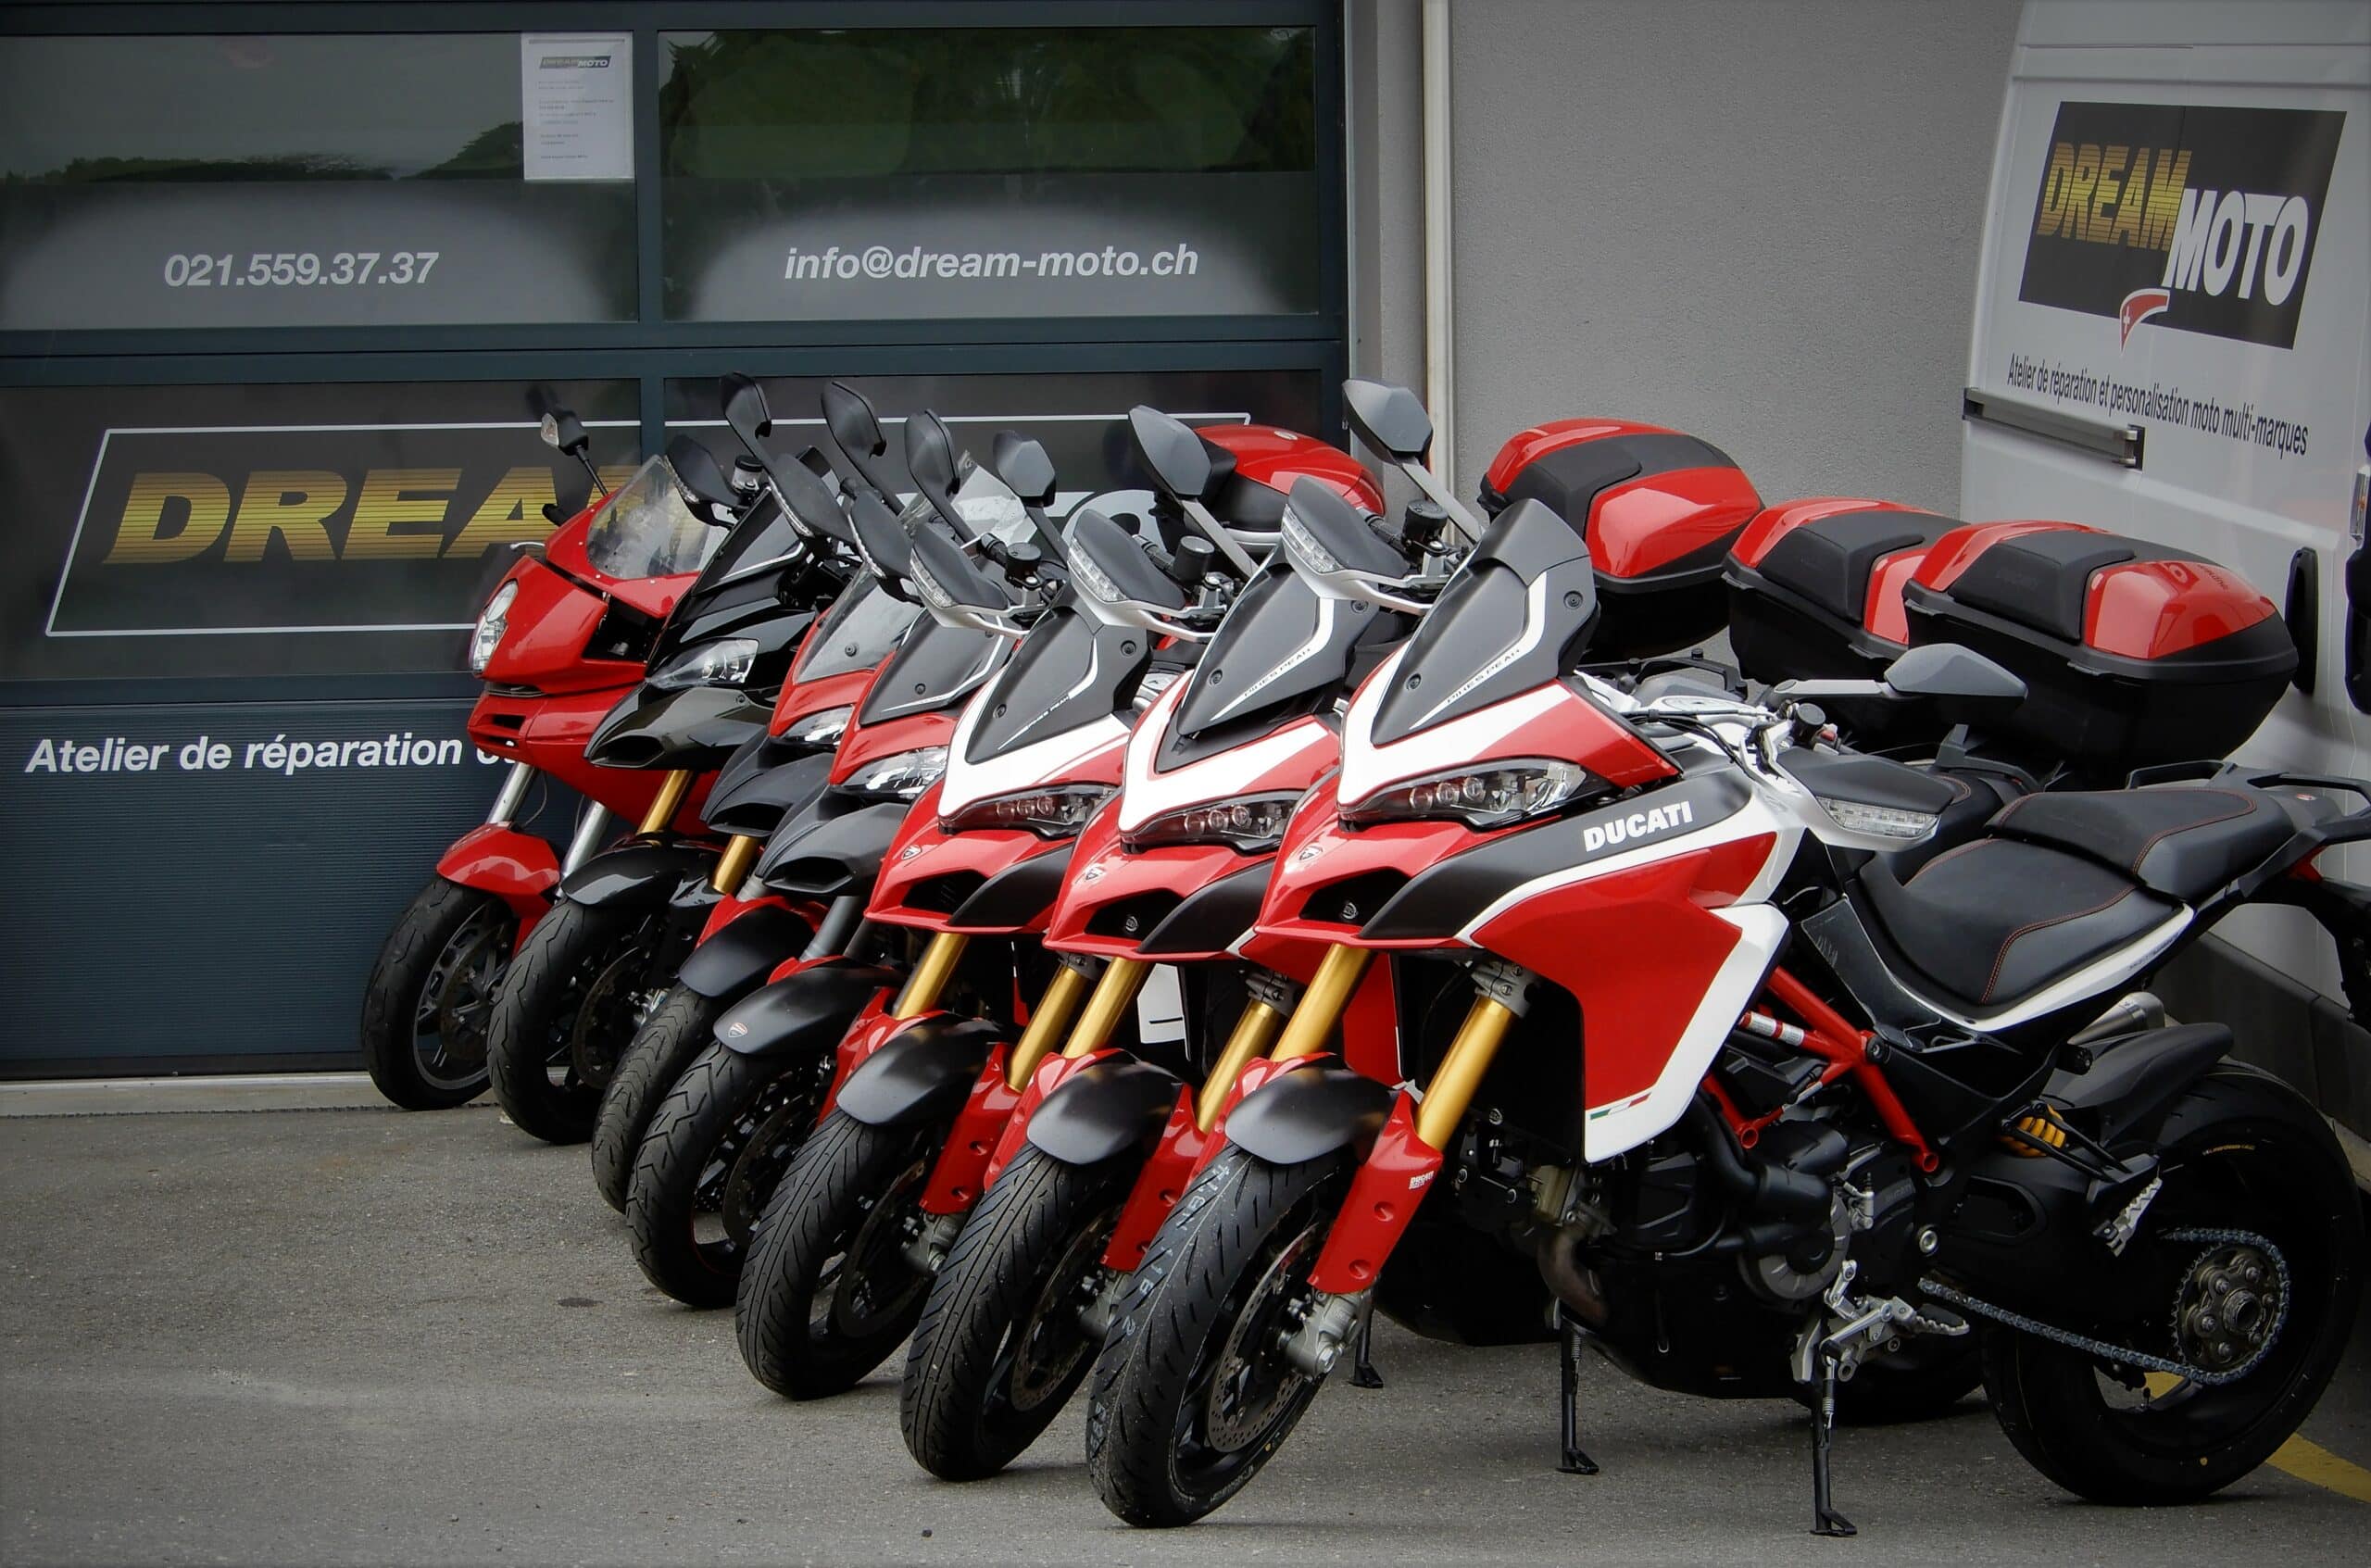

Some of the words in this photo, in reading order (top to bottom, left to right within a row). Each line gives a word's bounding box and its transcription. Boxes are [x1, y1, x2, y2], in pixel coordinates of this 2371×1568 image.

[578, 58, 609, 68] MOTO
[2038, 142, 2192, 252] DREAM
[2160, 187, 2309, 307] MOTO
[164, 251, 440, 287] 021.559.37.37
[784, 243, 1199, 280] info@dream-moto.ch
[2007, 352, 2037, 391] Atelier
[2038, 358, 2050, 394] de
[2050, 362, 2098, 405] réparation
[2099, 373, 2111, 408] et
[2109, 382, 2189, 427] personalisation
[2190, 396, 2221, 434] moto
[2221, 402, 2309, 460] multi-marques
[24, 737, 170, 773] Atelier
[179, 735, 232, 771] de
[244, 732, 463, 776] réparation
[1583, 800, 1694, 853] DUCATI
